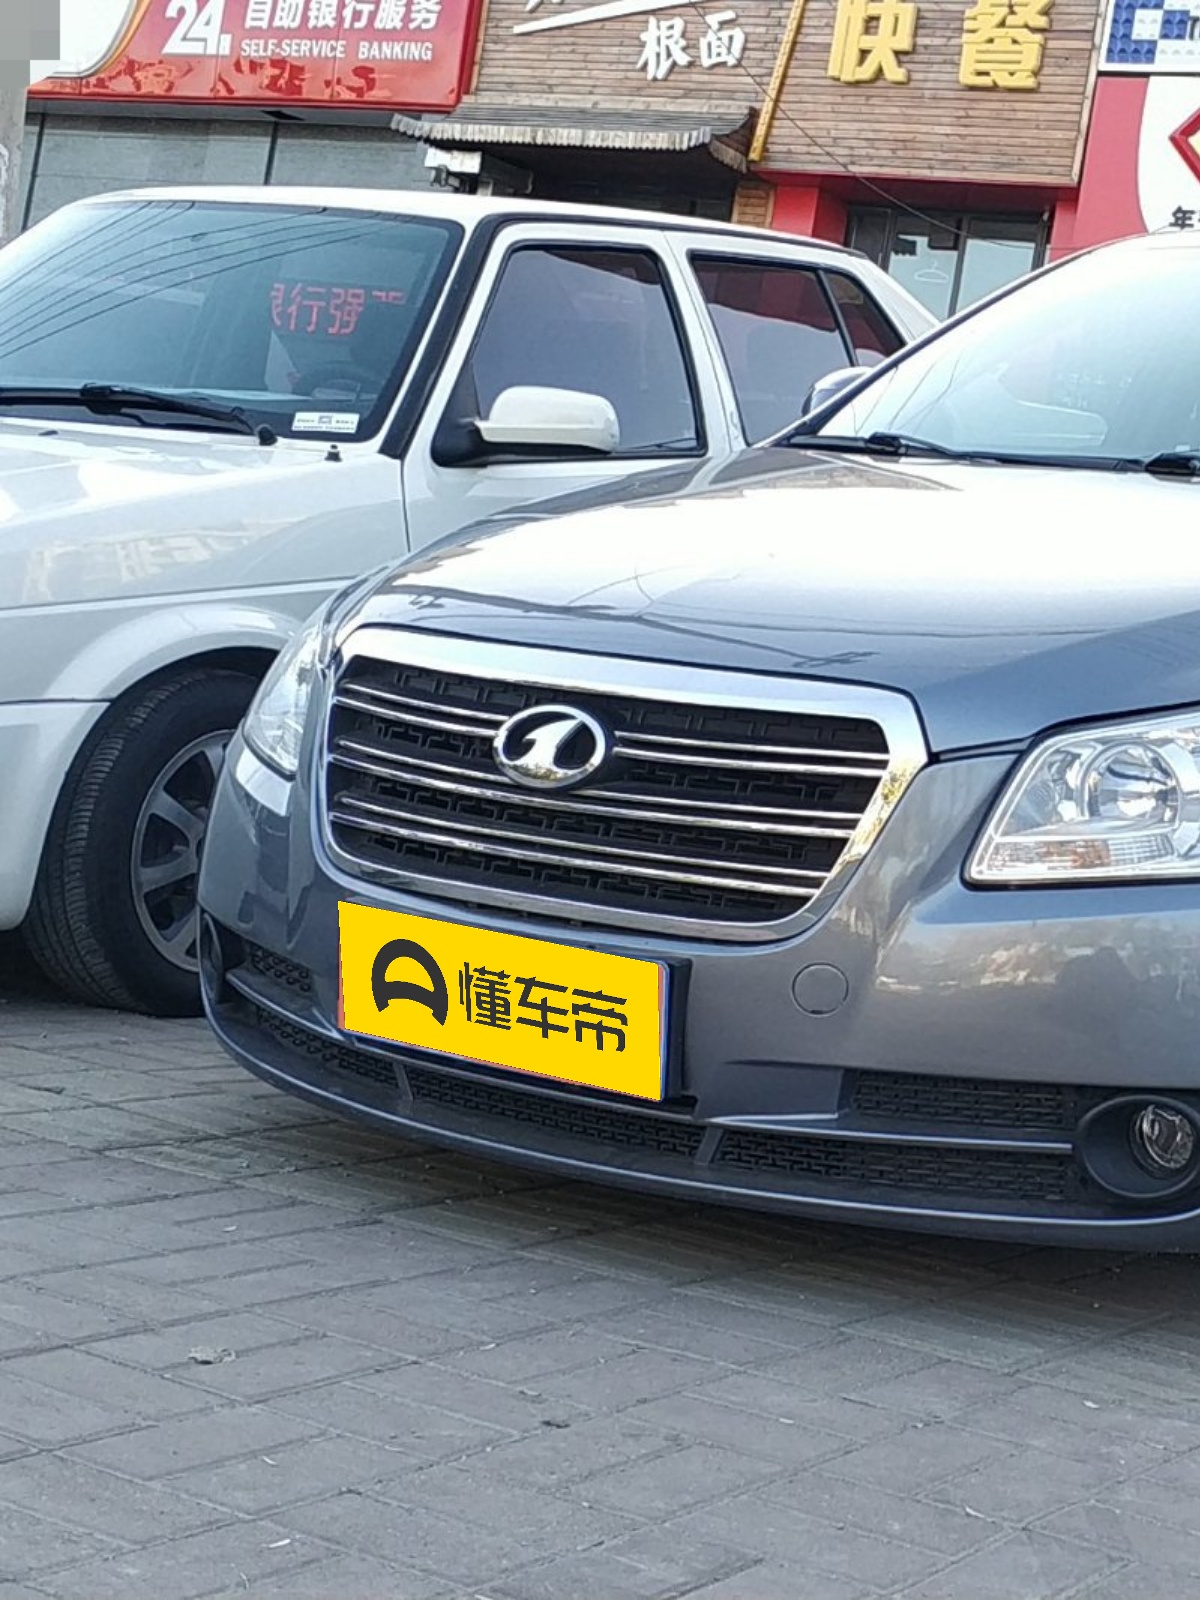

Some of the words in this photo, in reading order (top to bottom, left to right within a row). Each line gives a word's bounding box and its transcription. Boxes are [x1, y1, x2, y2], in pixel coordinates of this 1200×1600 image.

[243, 0, 442, 30] 自助银行服务
[240, 39, 346, 57] SELF-SERVICE
[358, 41, 433, 60] BANKING
[636, 10, 745, 80] 根面
[827, 0, 1050, 90] 快餐
